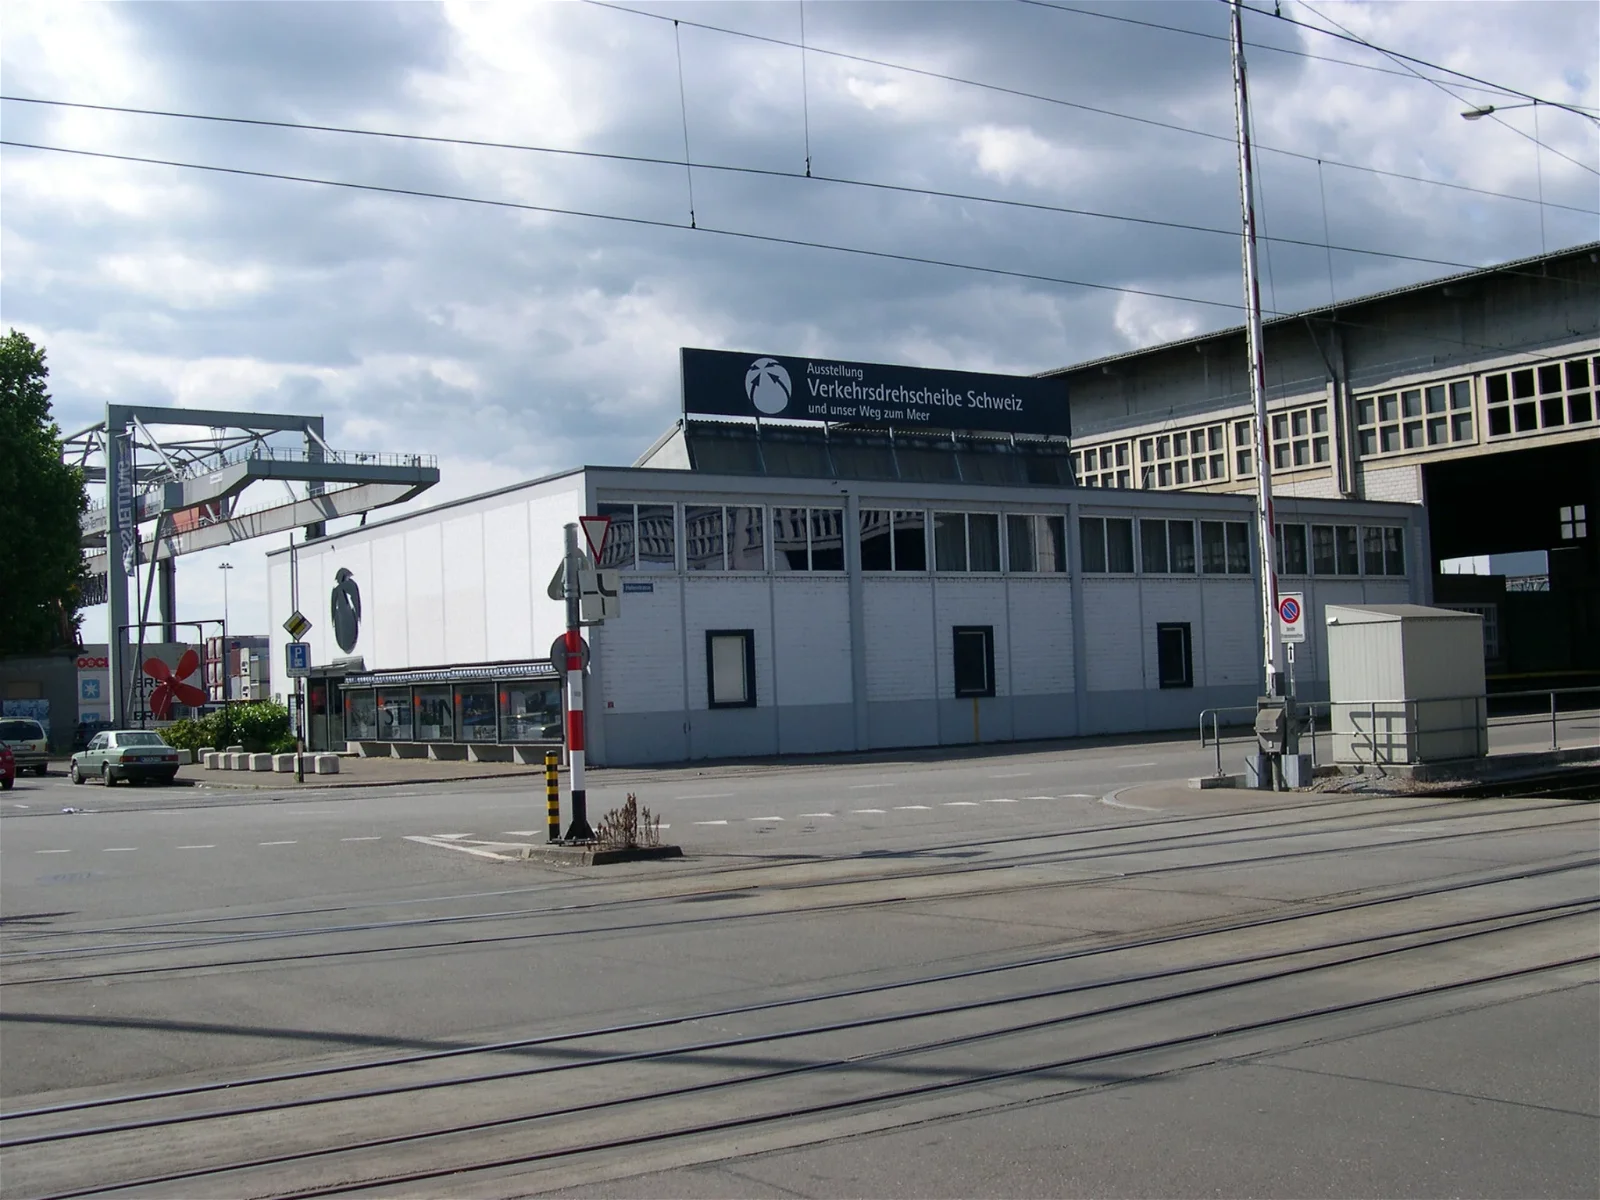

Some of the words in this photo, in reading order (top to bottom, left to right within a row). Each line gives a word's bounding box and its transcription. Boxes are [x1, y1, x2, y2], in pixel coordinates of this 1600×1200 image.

[806, 362, 864, 381] Ausstellung
[807, 377, 963, 408] Verkehrsdrehscheibe
[967, 390, 1023, 412] Schweiz
[808, 403, 827, 415] und
[830, 406, 856, 417] unser
[859, 404, 881, 421] Weg
[884, 409, 904, 420] zum
[906, 408, 930, 421] Meer
[295, 647, 302, 658] P
